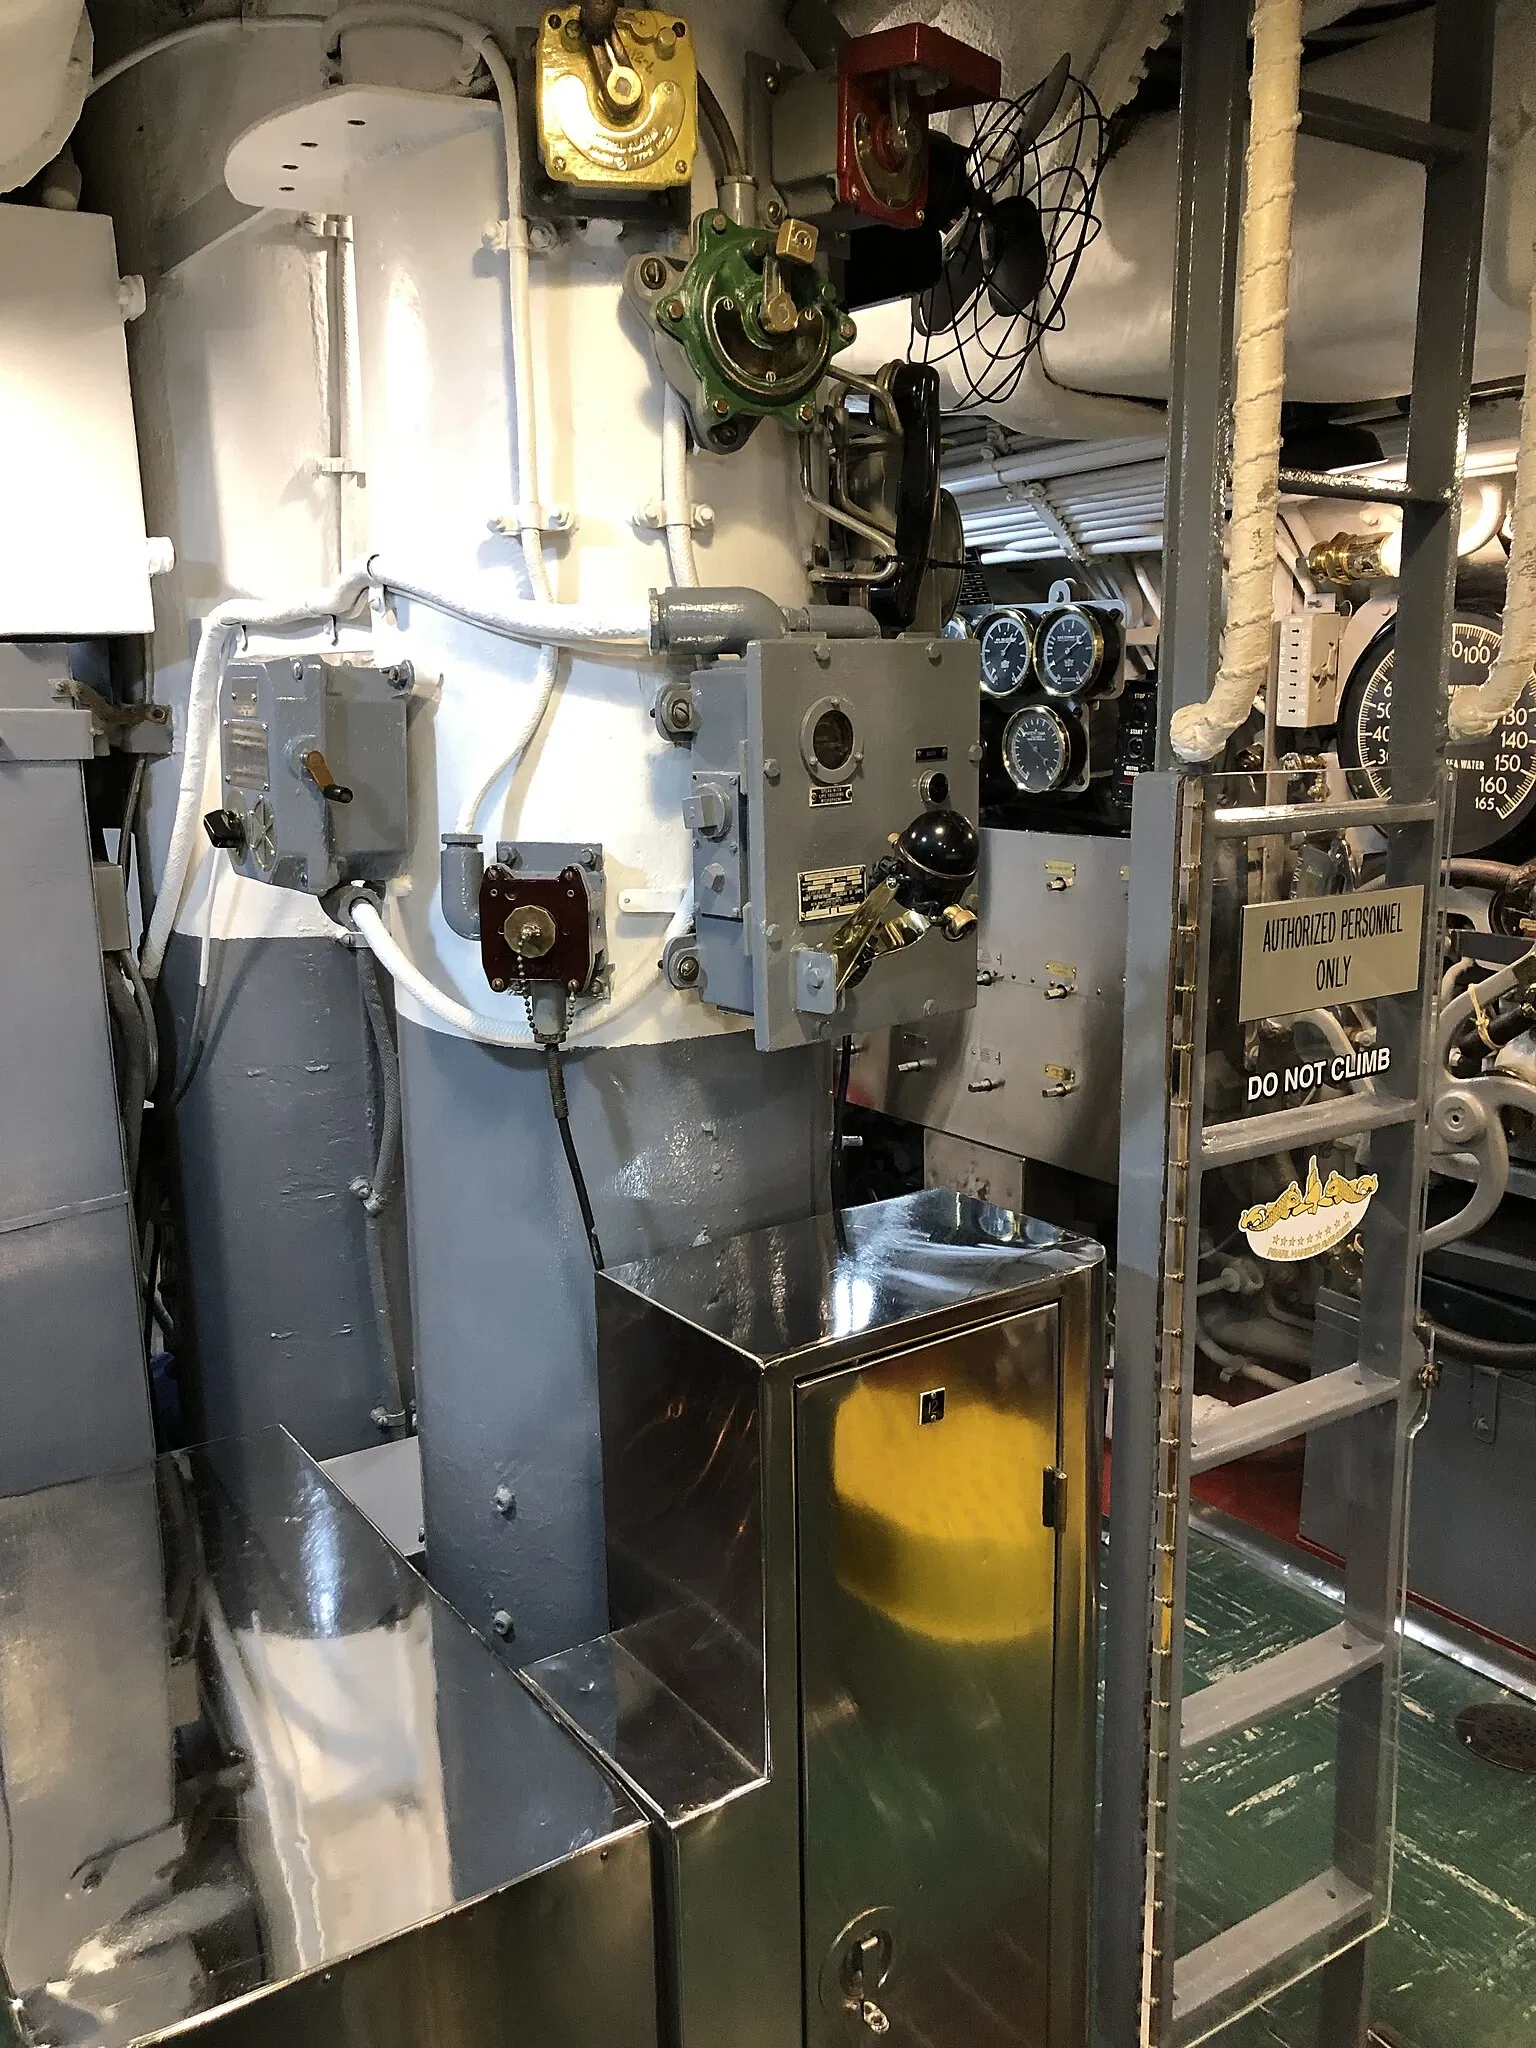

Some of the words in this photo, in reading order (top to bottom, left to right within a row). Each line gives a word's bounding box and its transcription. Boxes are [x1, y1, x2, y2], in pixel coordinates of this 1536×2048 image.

[1463, 645, 1491, 664] 100
[1502, 707, 1528, 725] 130
[1372, 725, 1390, 742] 40
[1501, 730, 1529, 749] 140
[1460, 759, 1485, 771] WATER
[1494, 754, 1521, 772] 150
[1479, 776, 1507, 794] 160
[1475, 797, 1495, 811] 165
[1262, 911, 1336, 953] AUTHORIZED
[1340, 902, 1403, 941] PERSONNEL
[1316, 955, 1351, 991] ONLY
[1248, 1072, 1279, 1100] DO
[1284, 1061, 1327, 1092] NOT
[1331, 1047, 1390, 1081] CLIMB
[928, 1400, 939, 1415] 12
